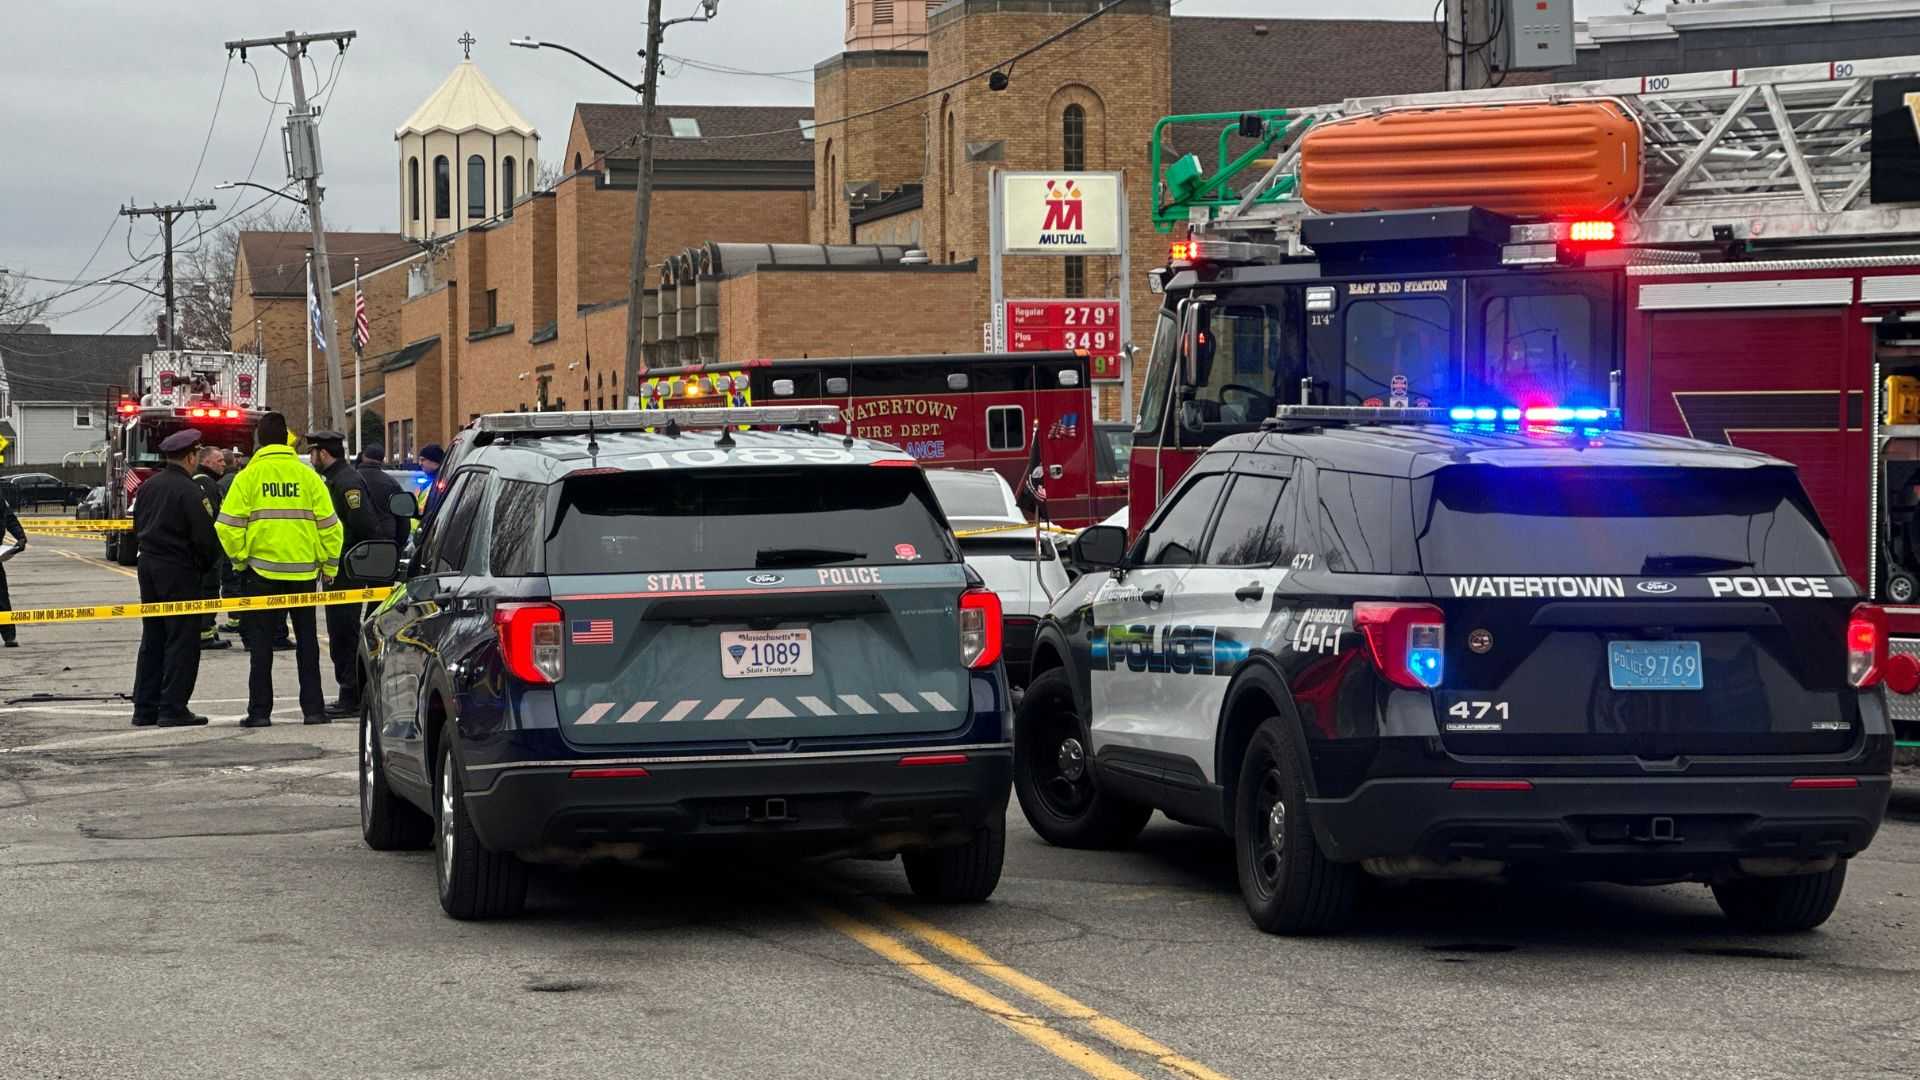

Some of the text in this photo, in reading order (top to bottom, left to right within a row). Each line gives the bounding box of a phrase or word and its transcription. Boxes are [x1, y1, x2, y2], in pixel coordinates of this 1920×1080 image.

[1836, 64, 1853, 76] 90
[1649, 78, 1669, 90] 100
[1039, 234, 1087, 244] MUTUAL
[1349, 280, 1448, 295] EAST END STATION
[1015, 307, 1044, 318] Regular
[1015, 332, 1031, 341] Plus
[840, 399, 958, 425] WATERTOWN
[857, 423, 942, 439] FIRE DEPT.
[262, 482, 300, 498] POLICE
[1292, 553, 1314, 569] 471
[648, 573, 705, 591] STATE
[816, 567, 881, 585] POLICE
[1450, 577, 1625, 597] WATERTOWN
[1707, 577, 1833, 598] POLICE
[1300, 624, 1342, 655] 9-1-1
[751, 642, 801, 666] 1089
[1614, 652, 1696, 677] POLICE 9769
[1449, 701, 1509, 720] 471
